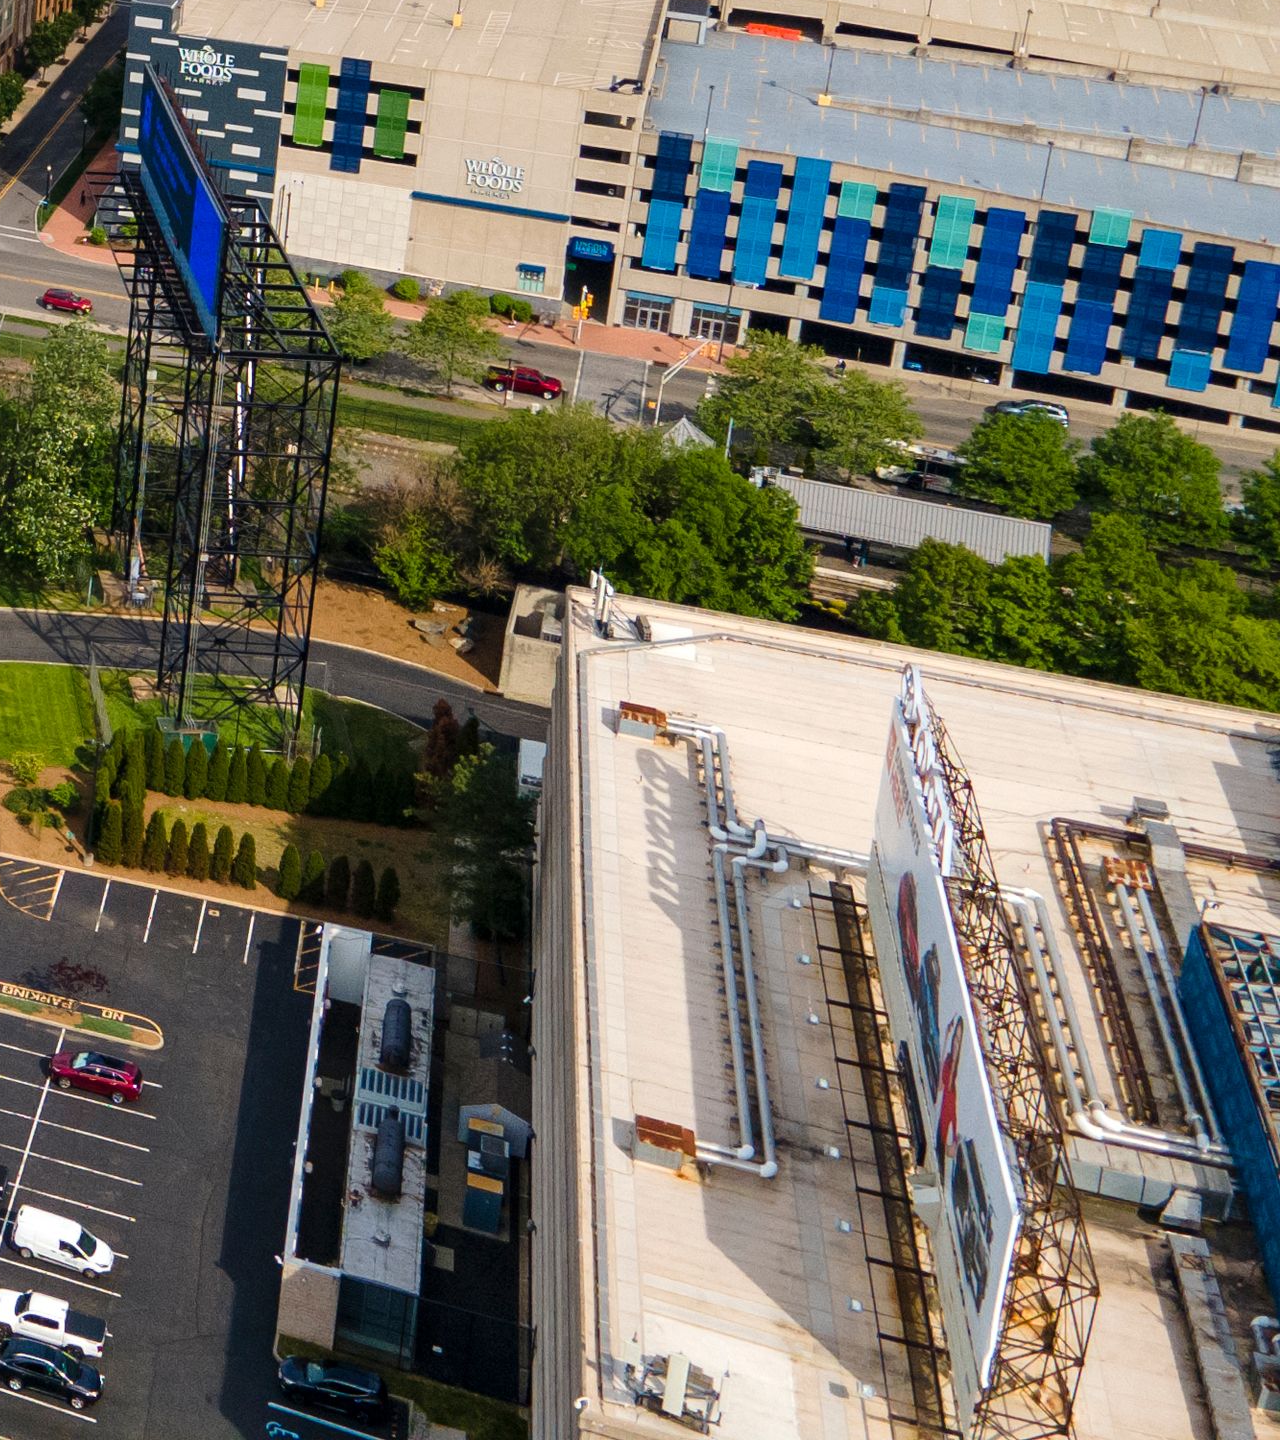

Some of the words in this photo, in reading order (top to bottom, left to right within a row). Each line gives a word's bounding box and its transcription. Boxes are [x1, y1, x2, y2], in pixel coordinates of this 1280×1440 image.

[178, 48, 236, 67] WHOLE
[180, 61, 232, 81] FOODS
[465, 159, 525, 179] WHOLE
[466, 172, 522, 193] FOODS
[1, 984, 78, 1010] PARKING
[101, 1008, 124, 1022] NO
